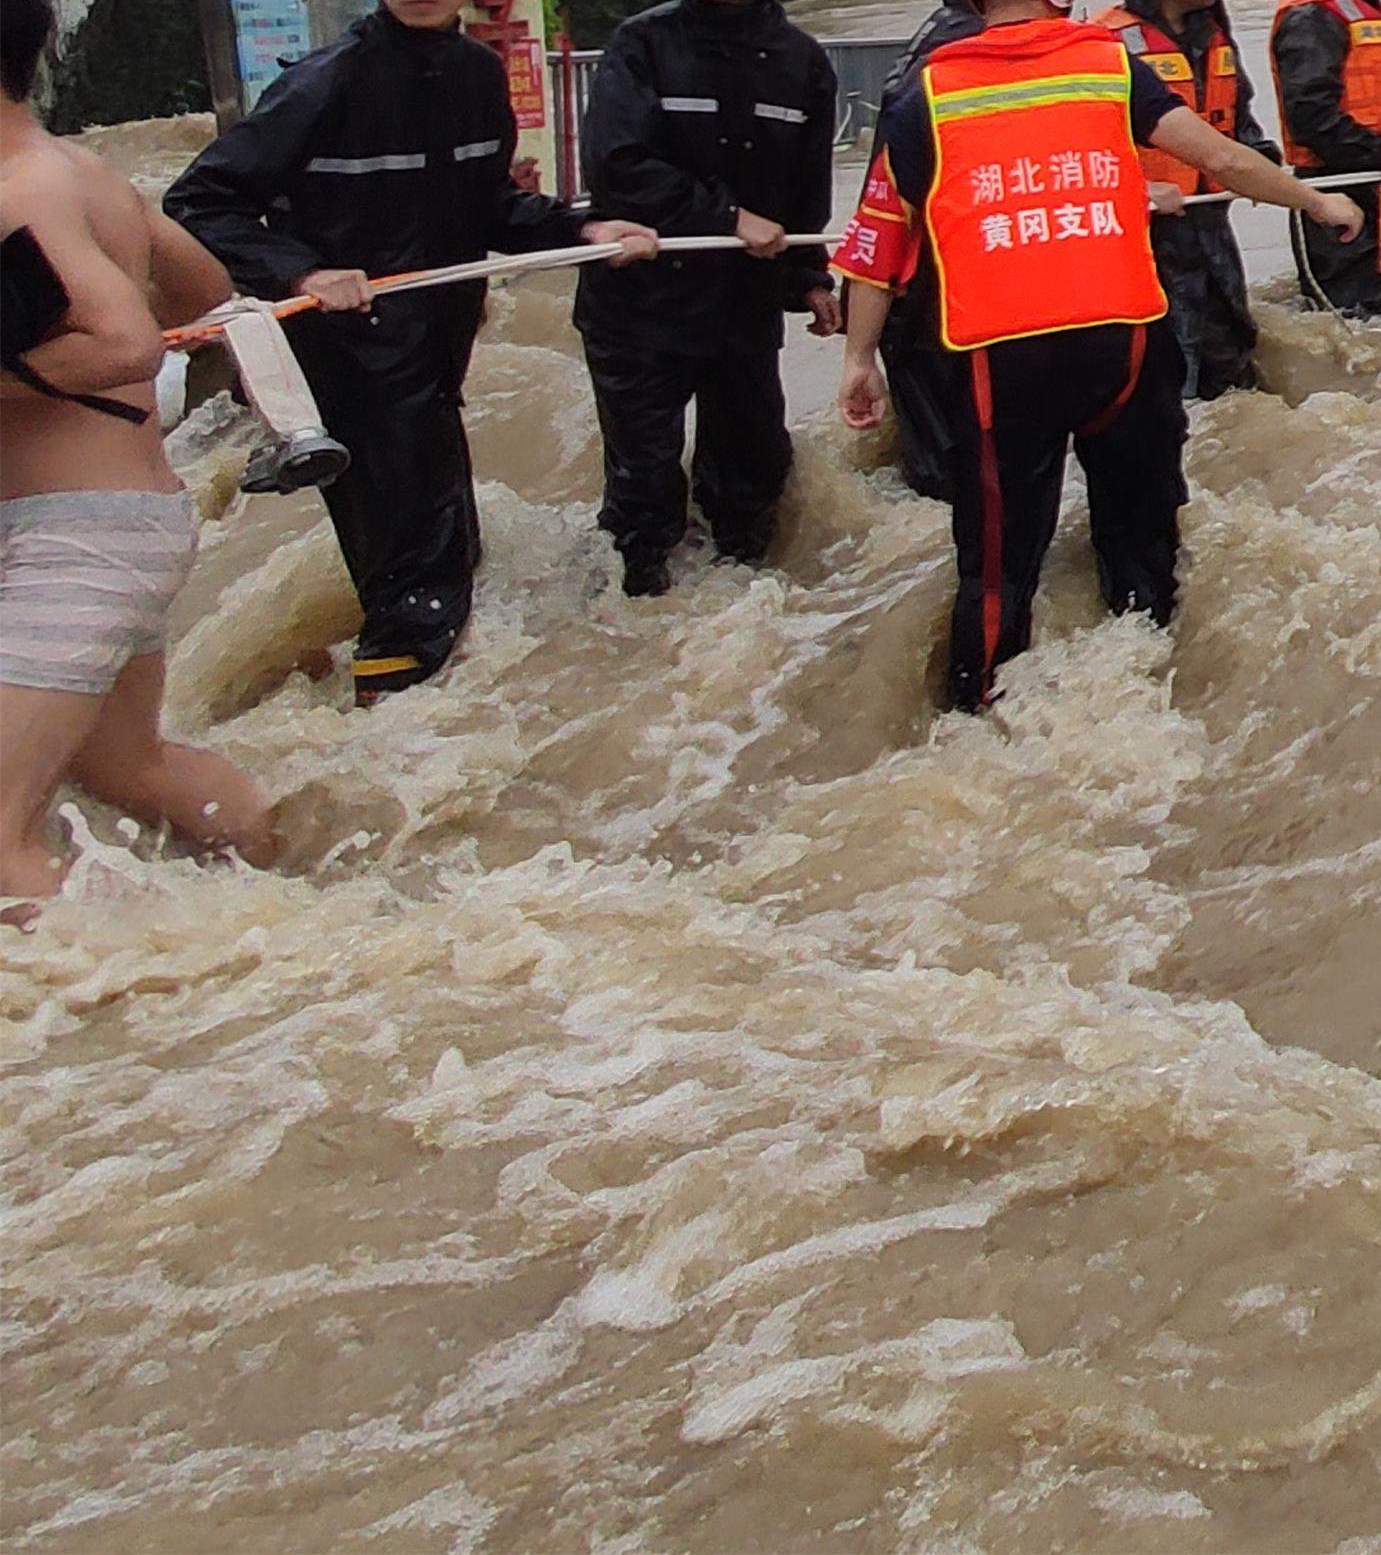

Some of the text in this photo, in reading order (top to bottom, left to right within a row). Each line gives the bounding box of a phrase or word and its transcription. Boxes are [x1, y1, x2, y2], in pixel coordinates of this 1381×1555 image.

[970, 149, 1120, 205] 湖北消防
[980, 200, 1125, 252] 黄冈支队
